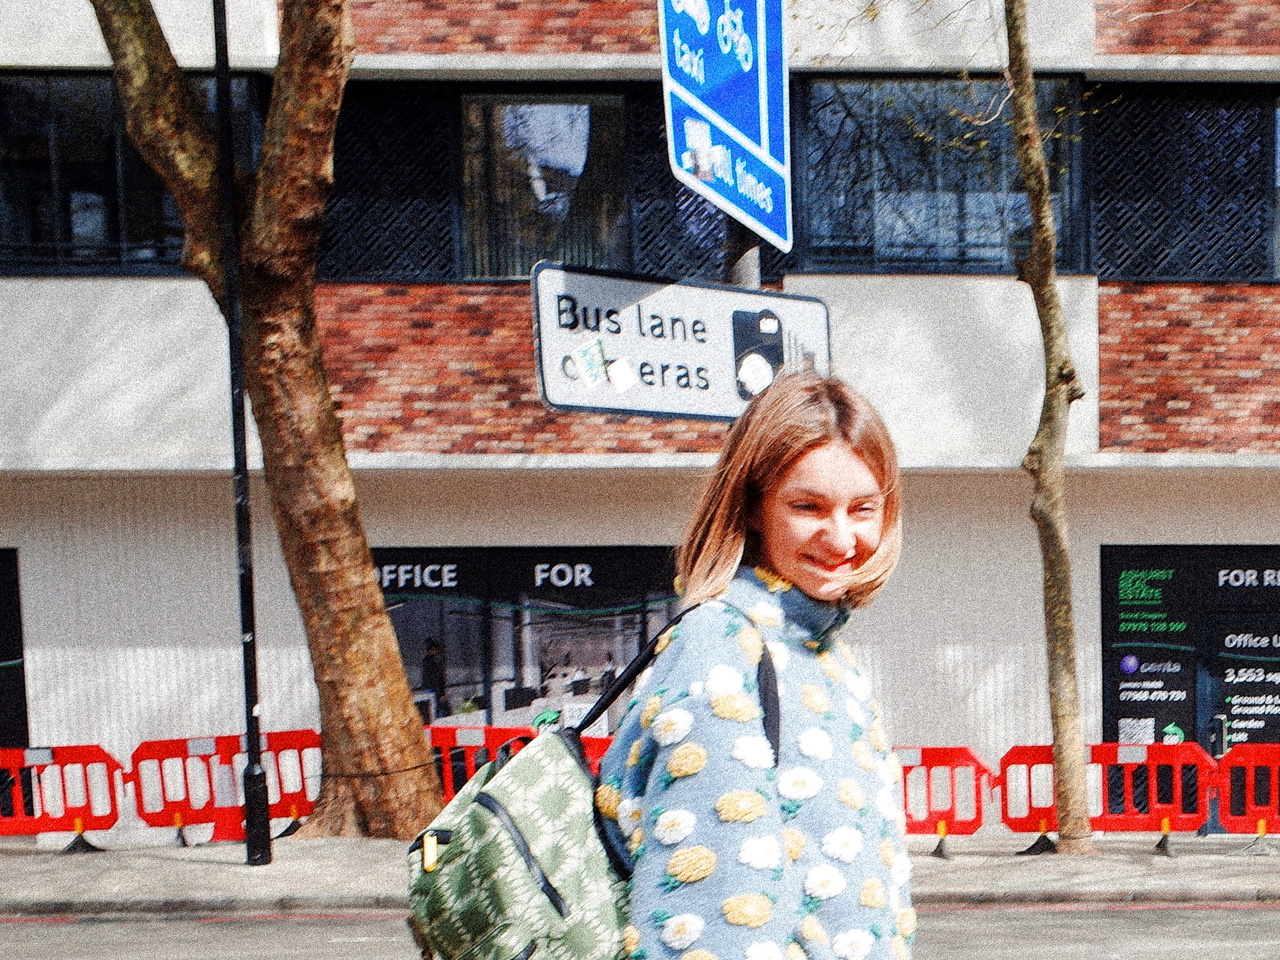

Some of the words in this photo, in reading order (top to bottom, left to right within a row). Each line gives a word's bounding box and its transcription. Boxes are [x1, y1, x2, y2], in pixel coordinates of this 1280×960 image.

[557, 294, 621, 335] Bus
[637, 304, 707, 343] lane
[562, 355, 710, 391] ceras
[534, 563, 594, 588] FOR
[1217, 568, 1258, 587] FOR
[1118, 588, 1162, 600] ESTATE
[1224, 633, 1269, 648] Office
[1265, 671, 1280, 685] sq
[1231, 694, 1265, 705] Ground
[1231, 704, 1265, 715] Ground
[1231, 718, 1265, 729] Garden
[1231, 730, 1249, 742] Lift
